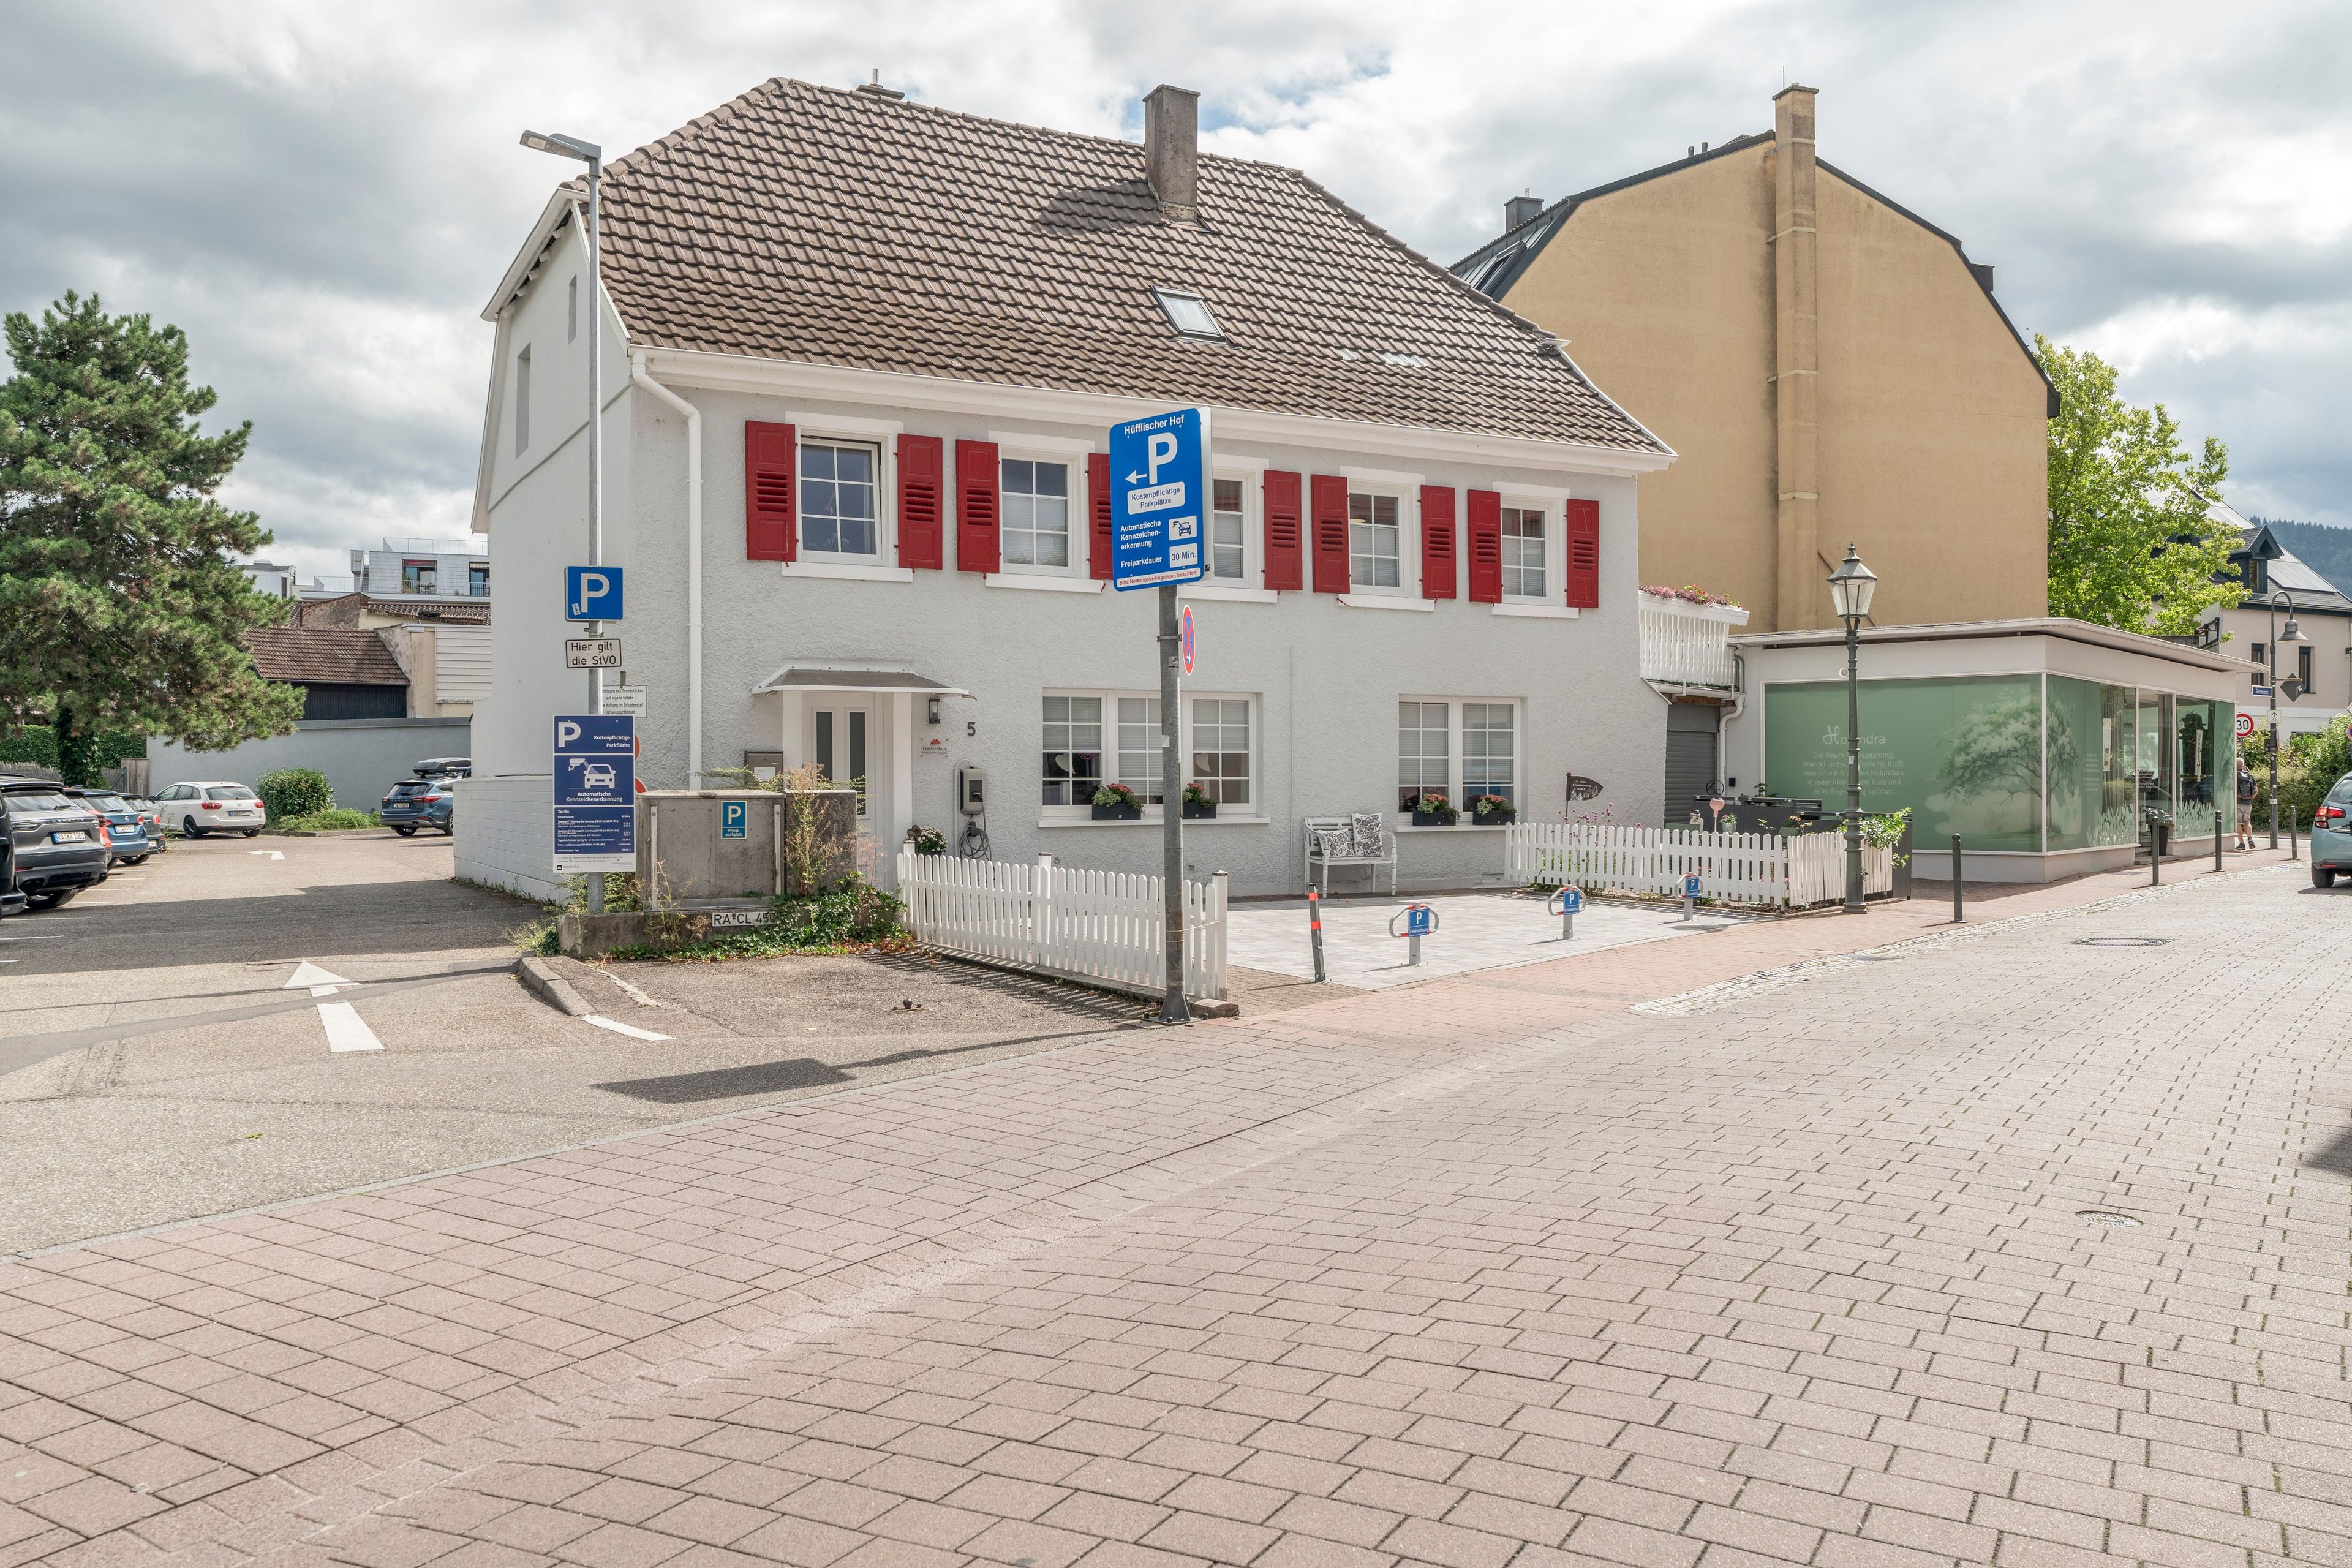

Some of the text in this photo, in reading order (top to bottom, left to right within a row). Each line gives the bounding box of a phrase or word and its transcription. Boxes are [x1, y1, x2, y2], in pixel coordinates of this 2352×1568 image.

[1125, 414, 1185, 435] Hüfflischer Hof
[1148, 432, 1178, 485] P
[1131, 487, 1180, 501] Kostenpflichtige
[1140, 497, 1172, 508] Parkplätze
[1120, 520, 1161, 532] Automatische
[1120, 530, 1161, 541] Kennzeichen-
[1121, 540, 1152, 550] erkennung
[1121, 556, 1163, 568] Freiparkdauer
[1171, 551, 1197, 561] 30 Min.
[1129, 573, 1176, 584] Nutzungsbedingungen
[581, 573, 610, 612] P
[571, 642, 613, 654] Hier gilt
[572, 655, 616, 665] die StVO
[967, 721, 976, 736] 5
[2236, 720, 2249, 730] 30
[558, 722, 581, 747] P
[1823, 725, 1885, 745] Hondra
[728, 805, 741, 824] P
[1691, 880, 1695, 889] P
[1570, 894, 1574, 905] P
[1417, 912, 1422, 924] P
